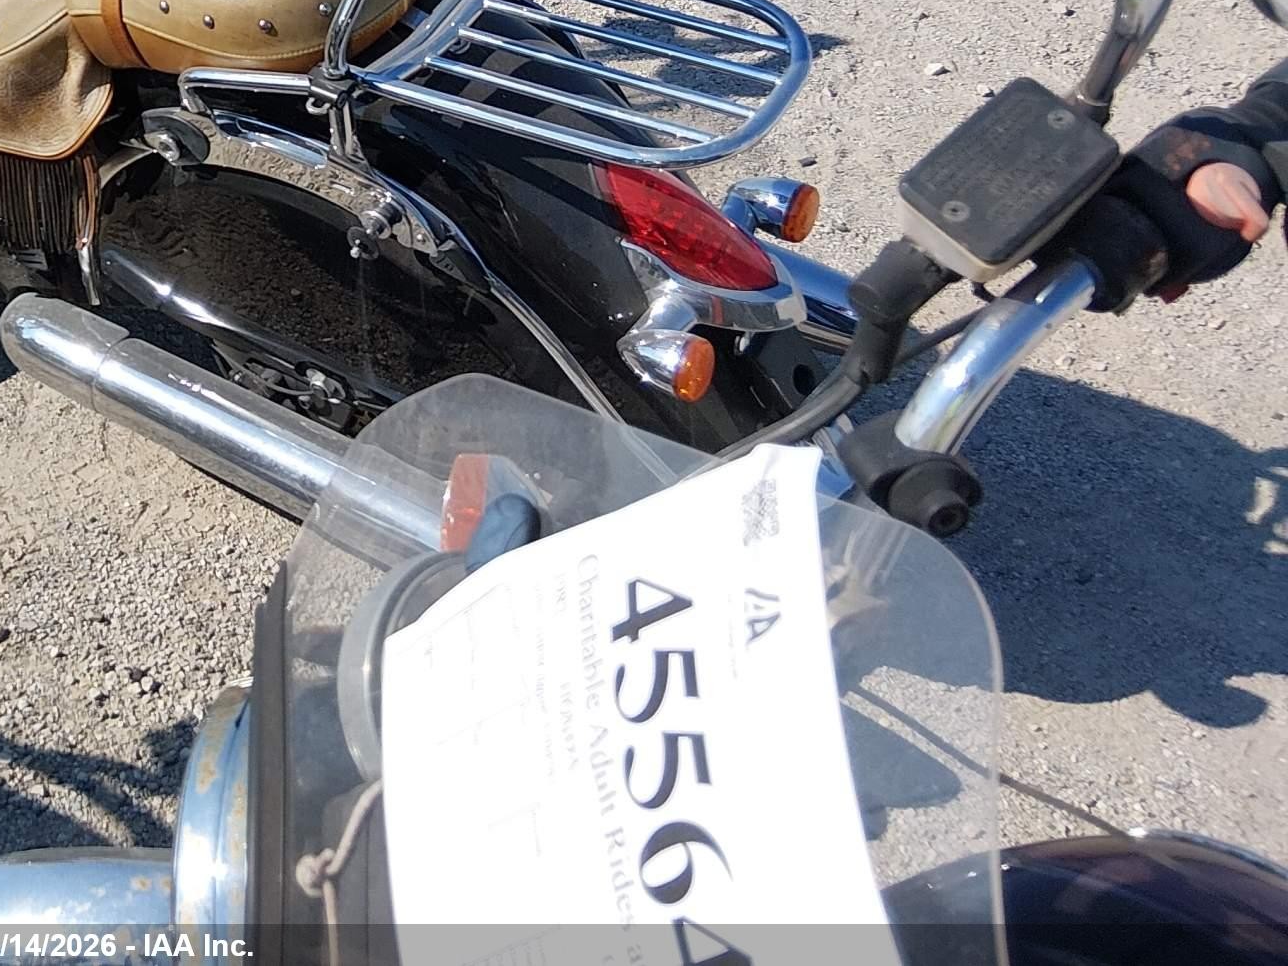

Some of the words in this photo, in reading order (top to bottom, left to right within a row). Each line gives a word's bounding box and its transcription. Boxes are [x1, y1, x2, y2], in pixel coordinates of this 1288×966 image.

[577, 554, 606, 710] Charitable
[590, 724, 618, 816] Adult
[605, 826, 636, 932] Rides
